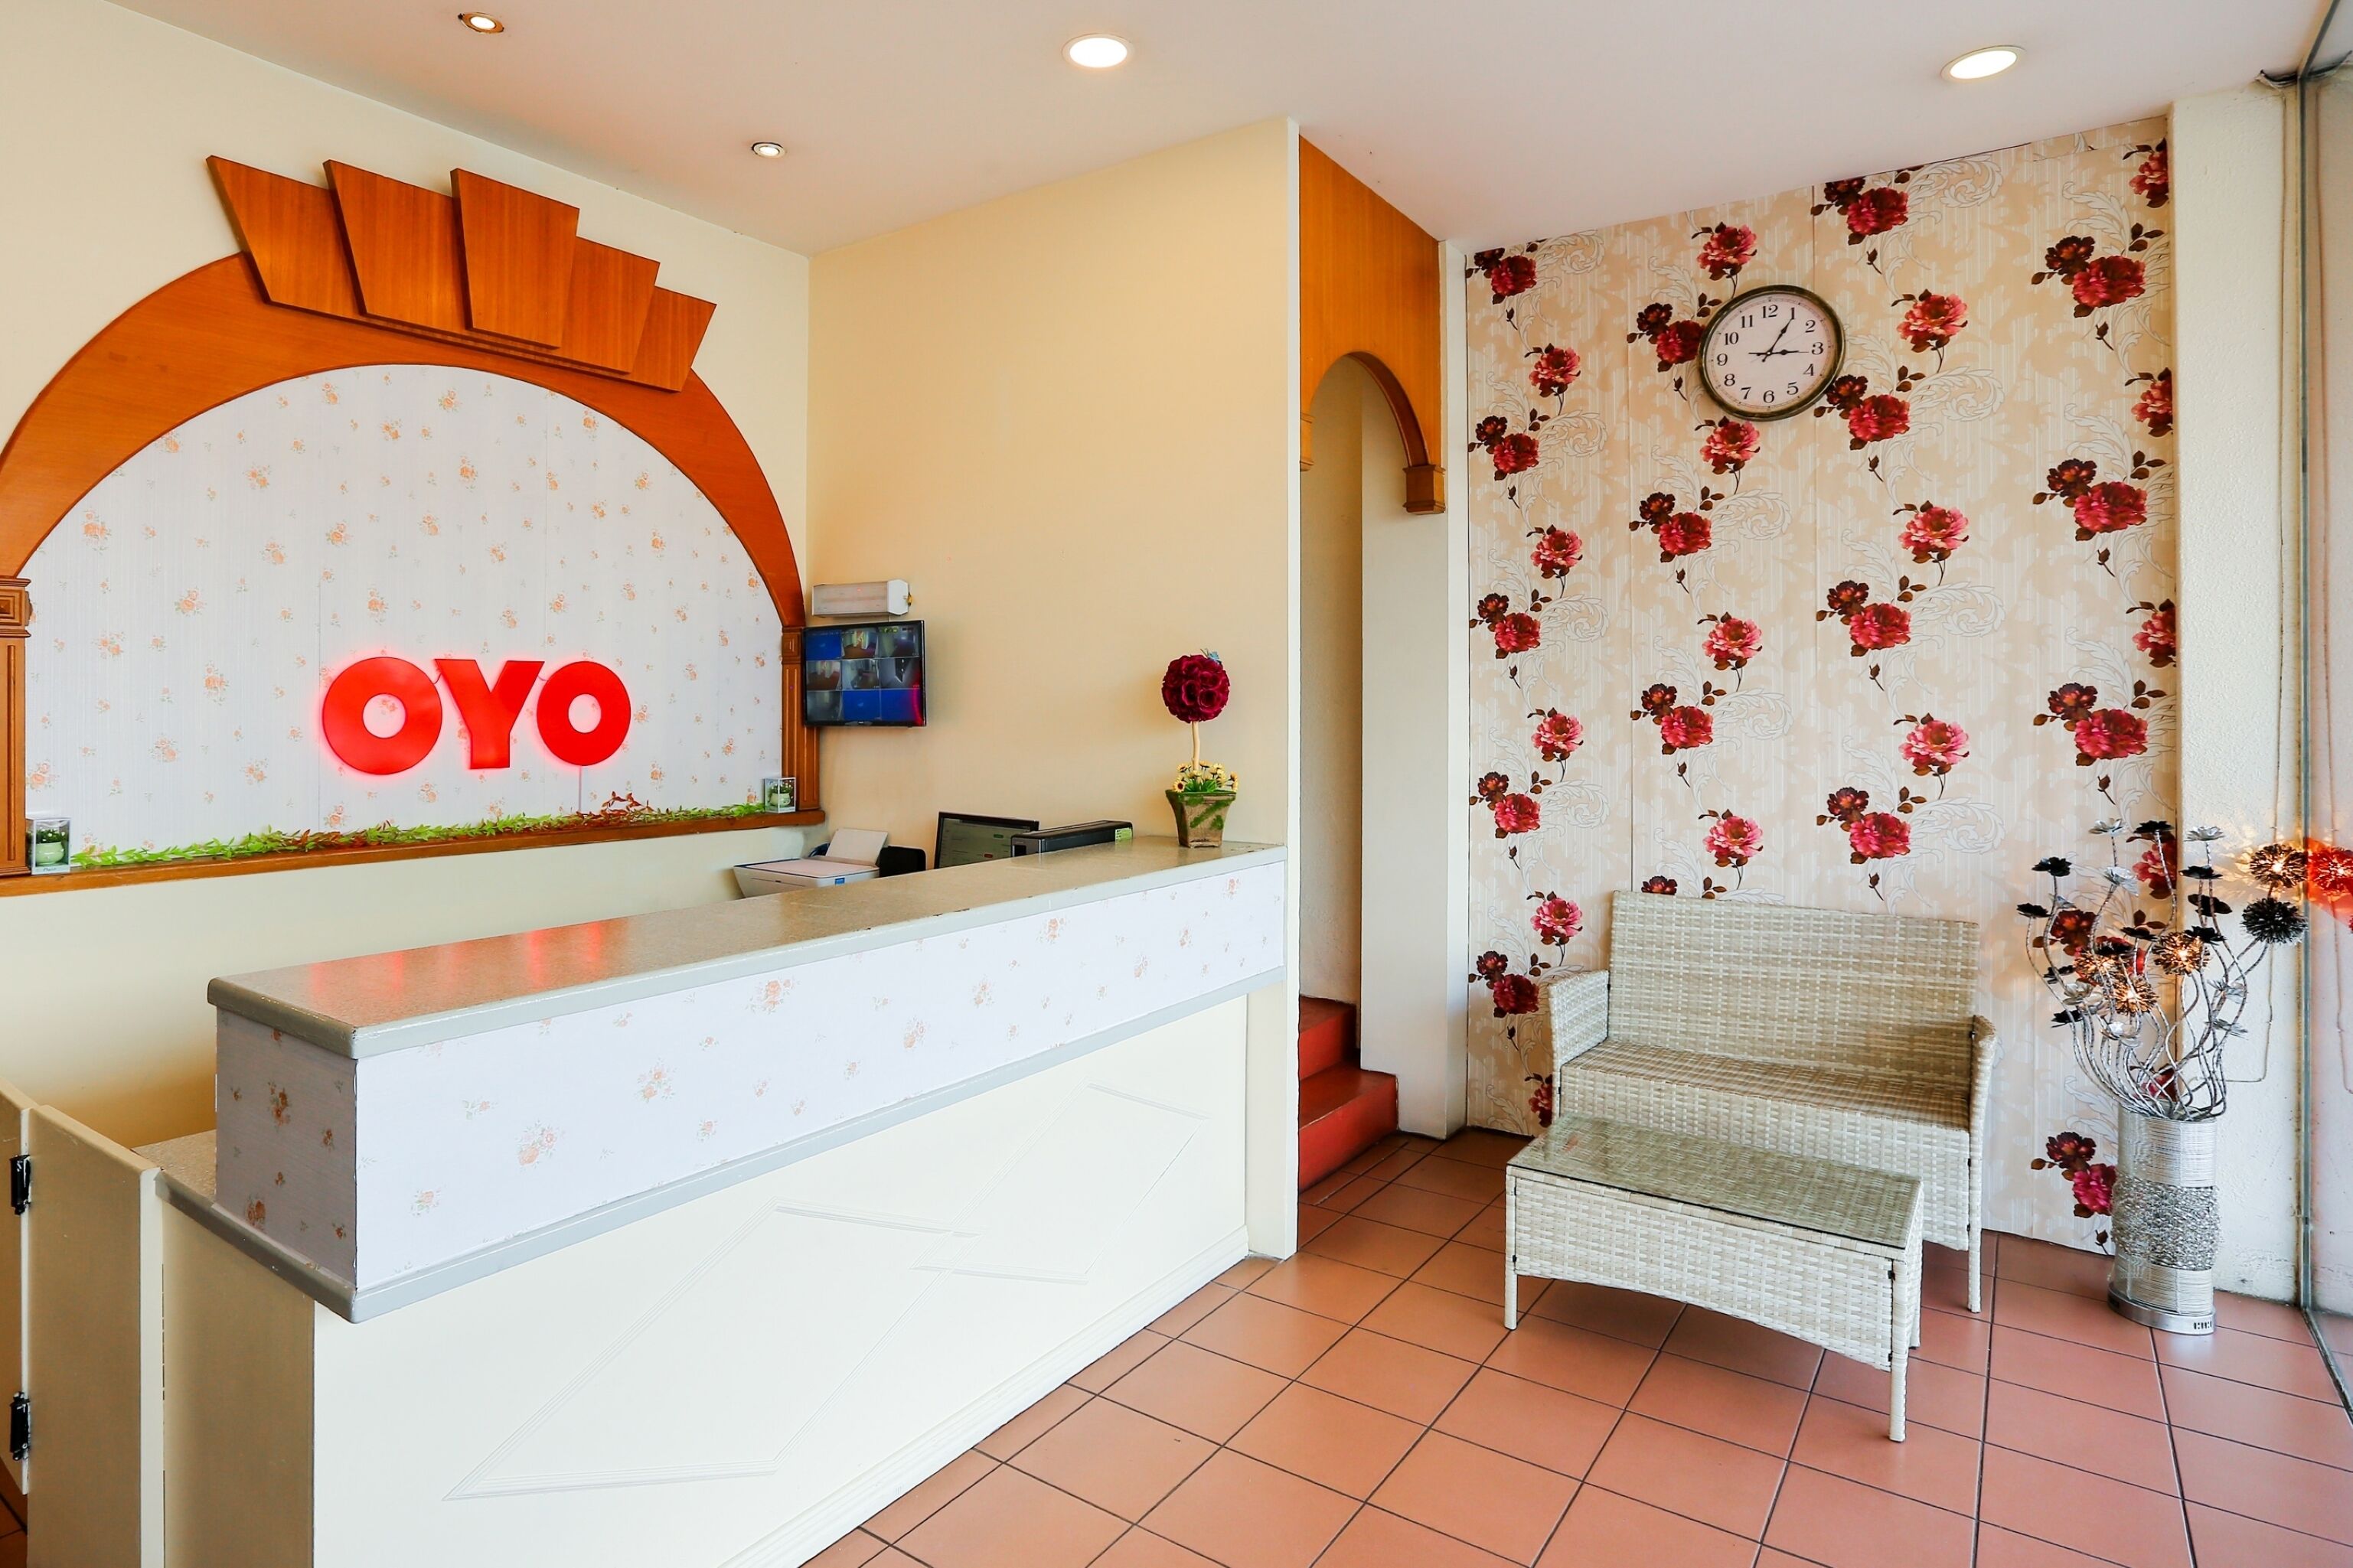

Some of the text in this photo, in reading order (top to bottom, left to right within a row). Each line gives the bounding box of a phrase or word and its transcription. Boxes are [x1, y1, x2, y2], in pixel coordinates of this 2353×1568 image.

[1762, 305, 1778, 318] 12
[1790, 307, 1795, 320] 1
[1741, 315, 1753, 328] 11
[1805, 319, 1816, 333] 2
[1724, 331, 1739, 345] 10
[1811, 342, 1824, 355] 3
[1716, 353, 1728, 366] 9
[1803, 363, 1814, 377] 4
[1724, 373, 1735, 386] 8
[1741, 386, 1751, 399] 7
[1787, 382, 1799, 395] 5
[1763, 390, 1775, 403] 6
[322, 657, 631, 775] OYO
